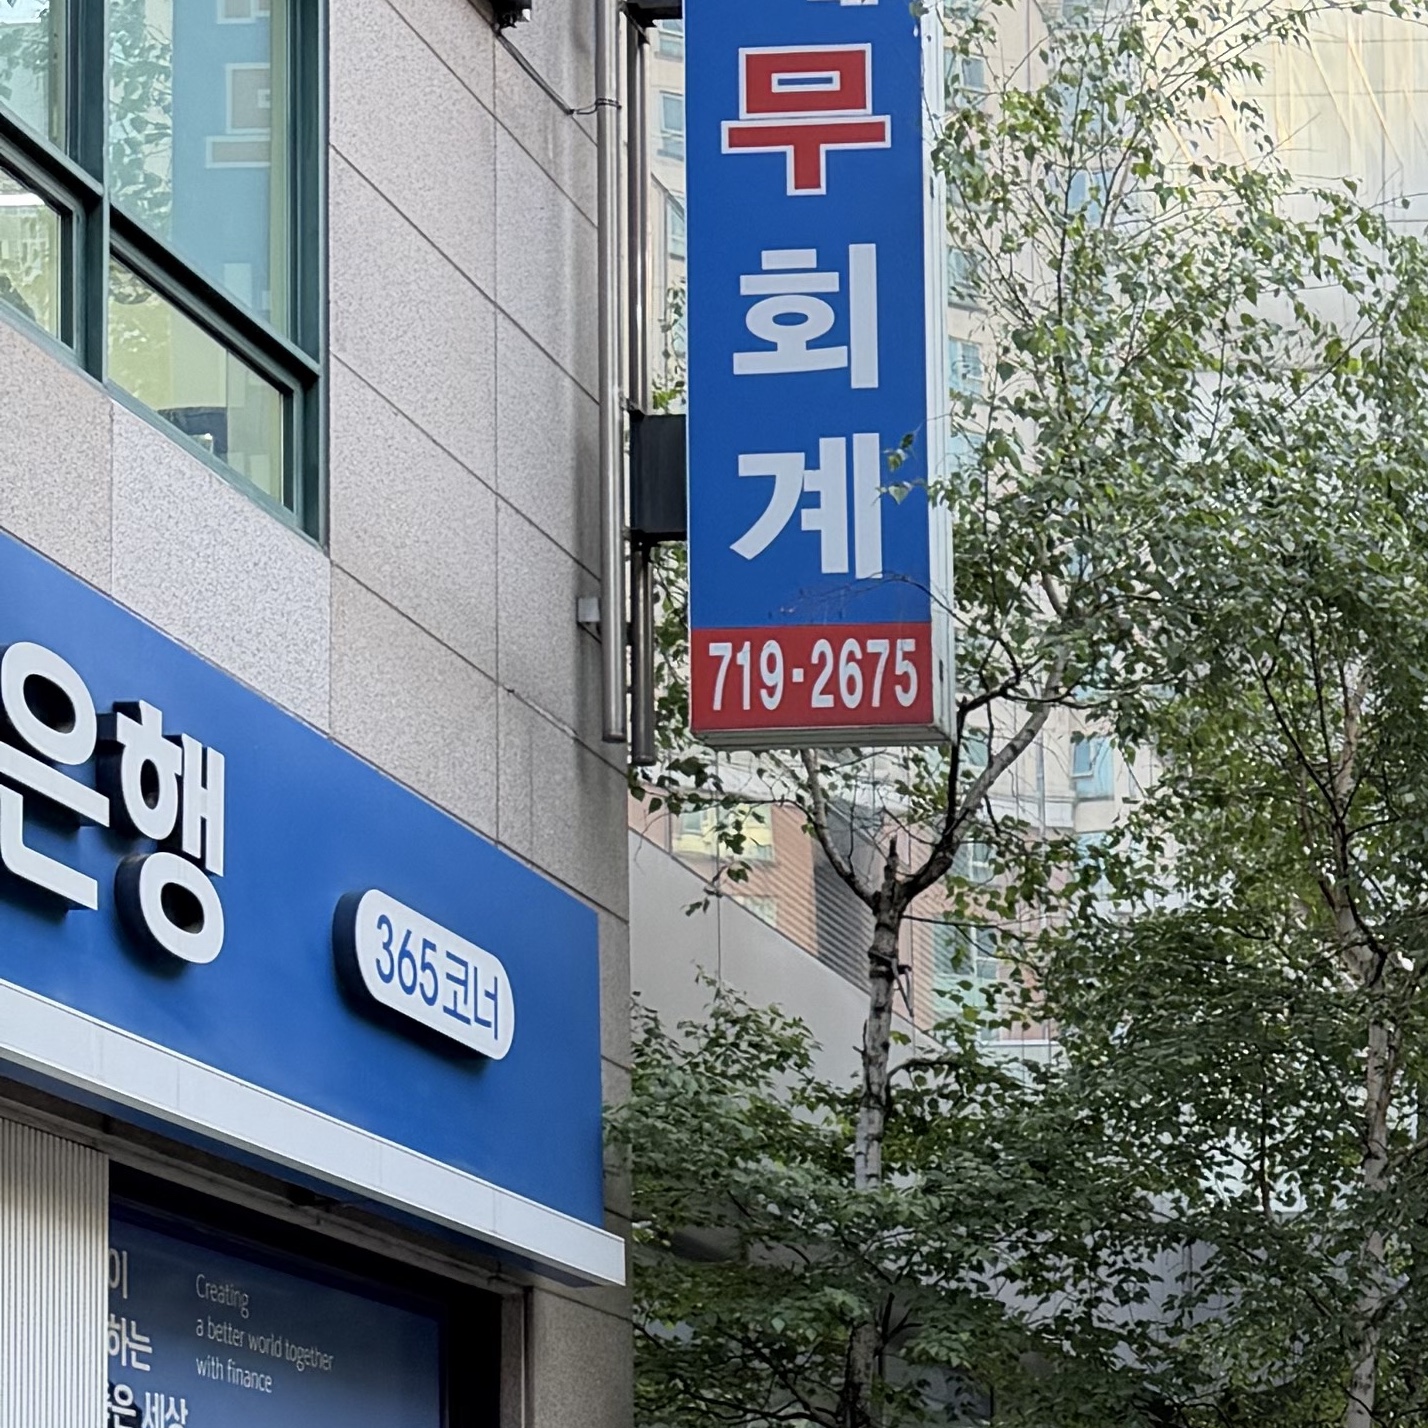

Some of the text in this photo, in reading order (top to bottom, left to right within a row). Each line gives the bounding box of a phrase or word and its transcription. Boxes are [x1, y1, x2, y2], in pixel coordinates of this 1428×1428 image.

[721, 0, 891, 580] 무회계
[707, 637, 919, 712] 719-2675
[0, 641, 225, 965] 은행
[373, 913, 501, 1041] 365코너
[195, 1272, 250, 1319] Creating
[108, 1312, 153, 1372] 하는
[195, 1314, 336, 1373] a better world together
[195, 1354, 273, 1394] with finance
